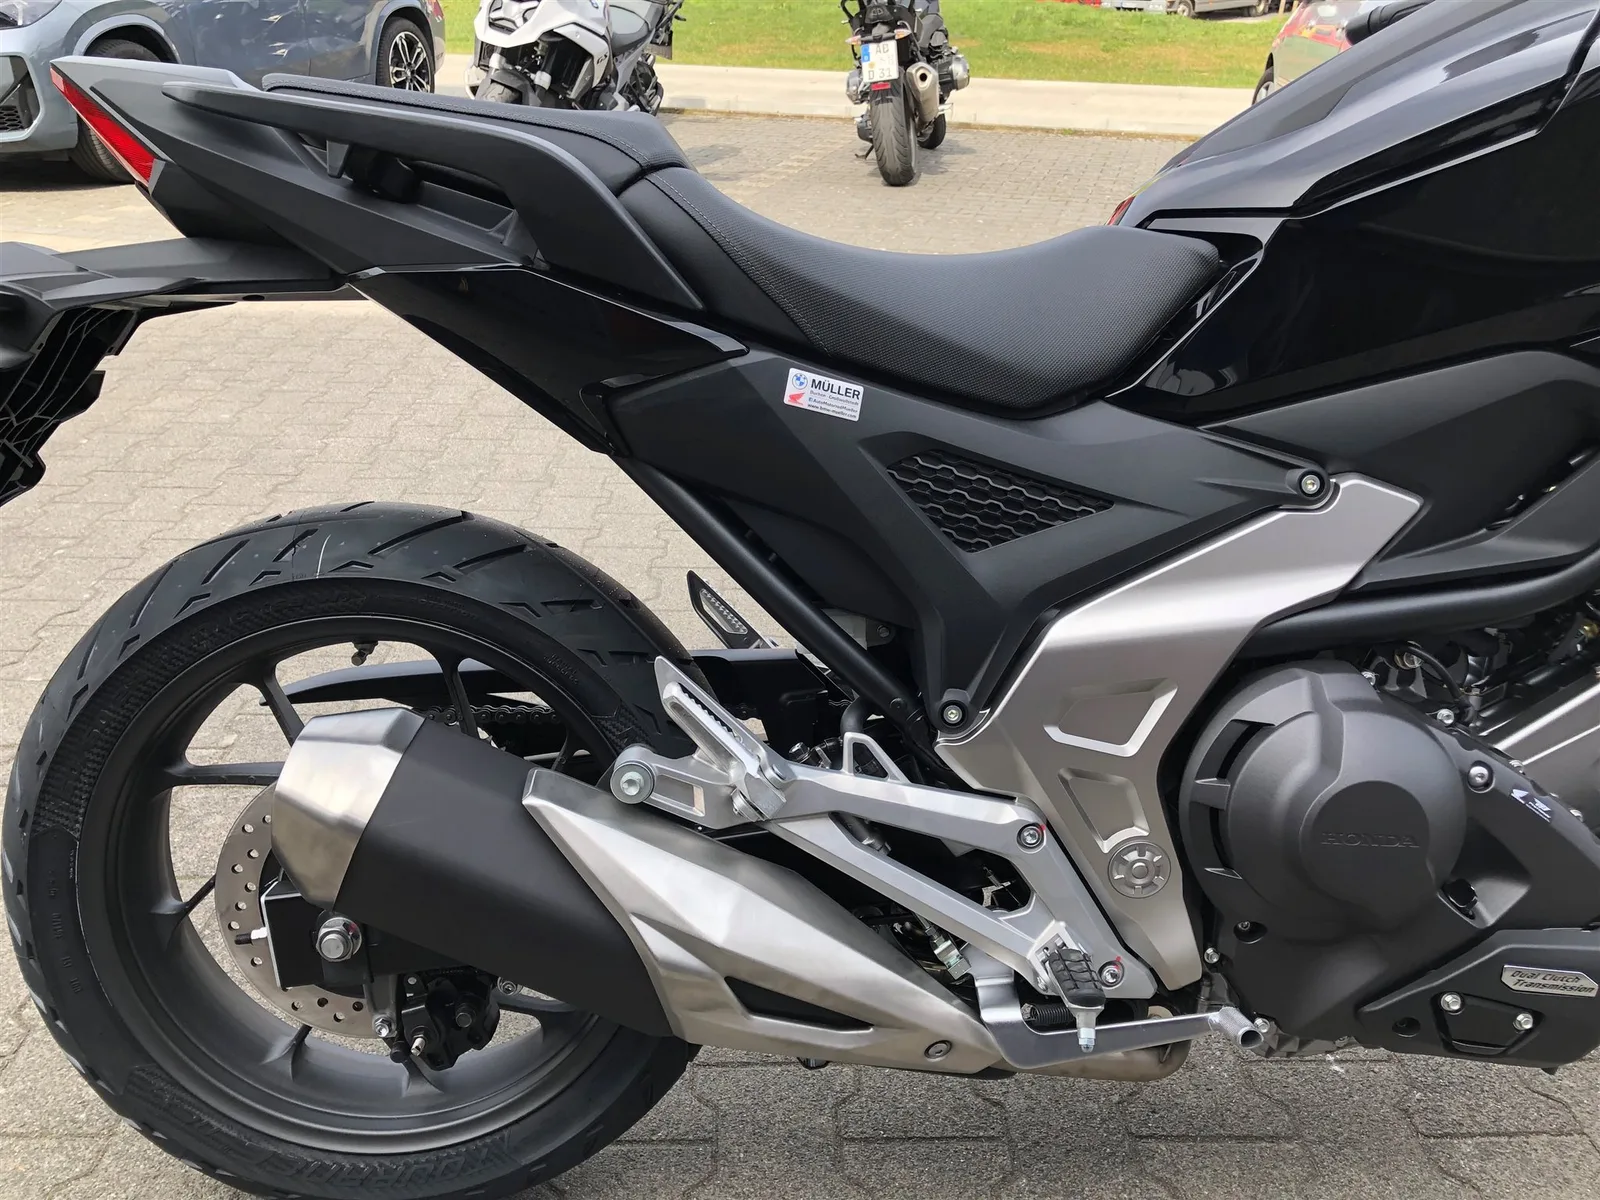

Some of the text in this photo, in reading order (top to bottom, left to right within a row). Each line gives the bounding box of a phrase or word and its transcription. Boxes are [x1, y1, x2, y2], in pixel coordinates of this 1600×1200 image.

[879, 68, 892, 78] 31
[811, 379, 861, 400] MÜLLER
[1321, 832, 1420, 848] HONDA
[1511, 970, 1581, 983] Dual Clutch
[1512, 979, 1595, 993] Transmission
